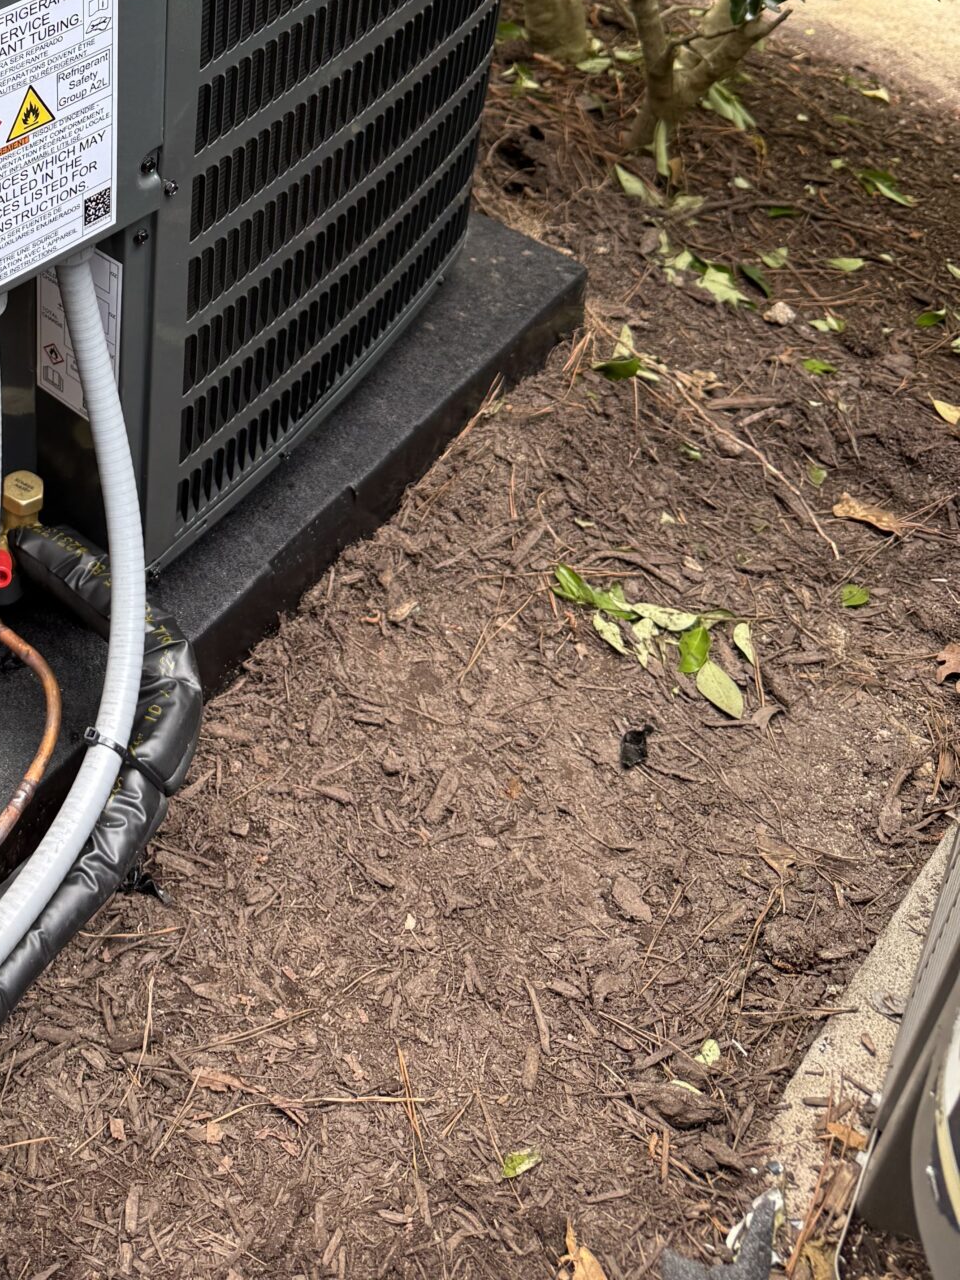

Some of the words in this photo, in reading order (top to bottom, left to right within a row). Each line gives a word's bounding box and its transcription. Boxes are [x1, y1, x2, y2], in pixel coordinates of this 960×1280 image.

[30, 13, 83, 43] TUBING.
[58, 52, 109, 83] Refrigerant
[68, 71, 99, 91] Safety
[58, 89, 88, 109] Group
[89, 79, 108, 93] A2L
[32, 146, 76, 177] WHICH
[78, 130, 106, 155] MAY
[24, 178, 67, 209] LISTED
[72, 161, 98, 182] FOR
[41, 169, 54, 185] IN
[56, 156, 82, 178] THE
